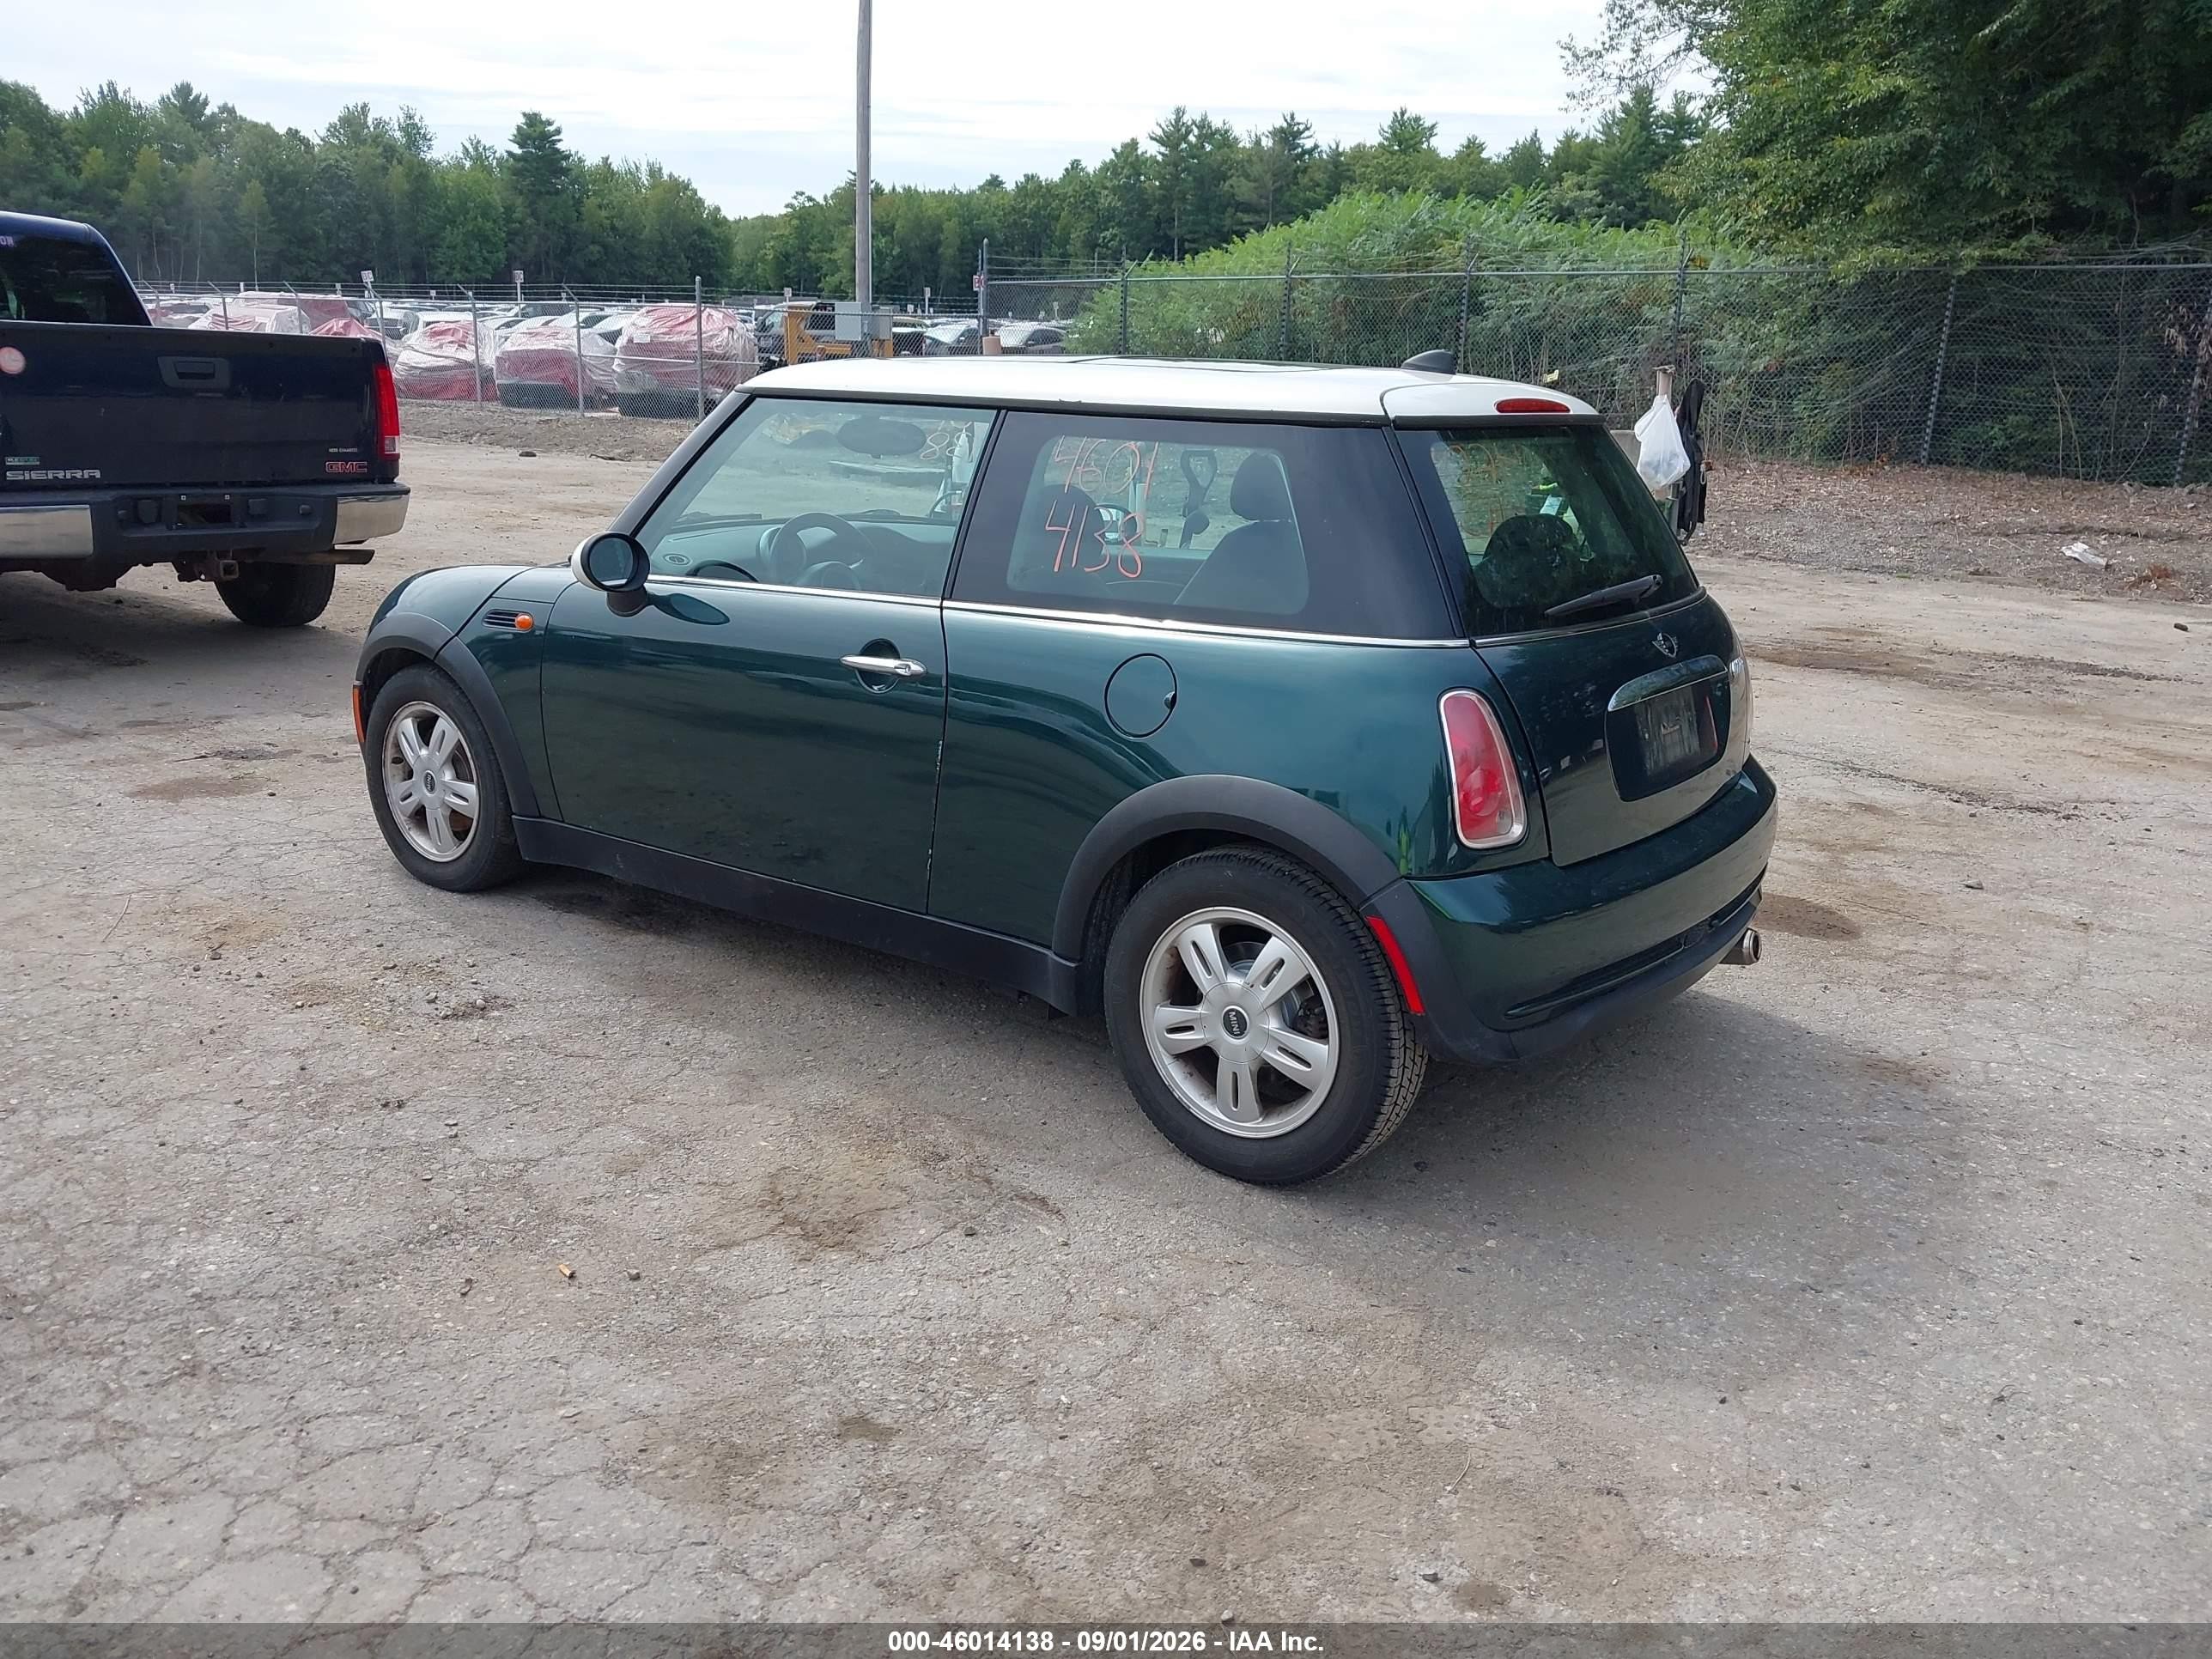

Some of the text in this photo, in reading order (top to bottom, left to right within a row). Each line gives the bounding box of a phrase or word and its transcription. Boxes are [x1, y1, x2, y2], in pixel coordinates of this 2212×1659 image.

[6, 470, 101, 480] SIERRA
[325, 461, 368, 473] GMC
[1054, 434, 1159, 501] 4601
[1045, 500, 1144, 578] 4138
[1229, 1012, 1240, 1034] MINI
